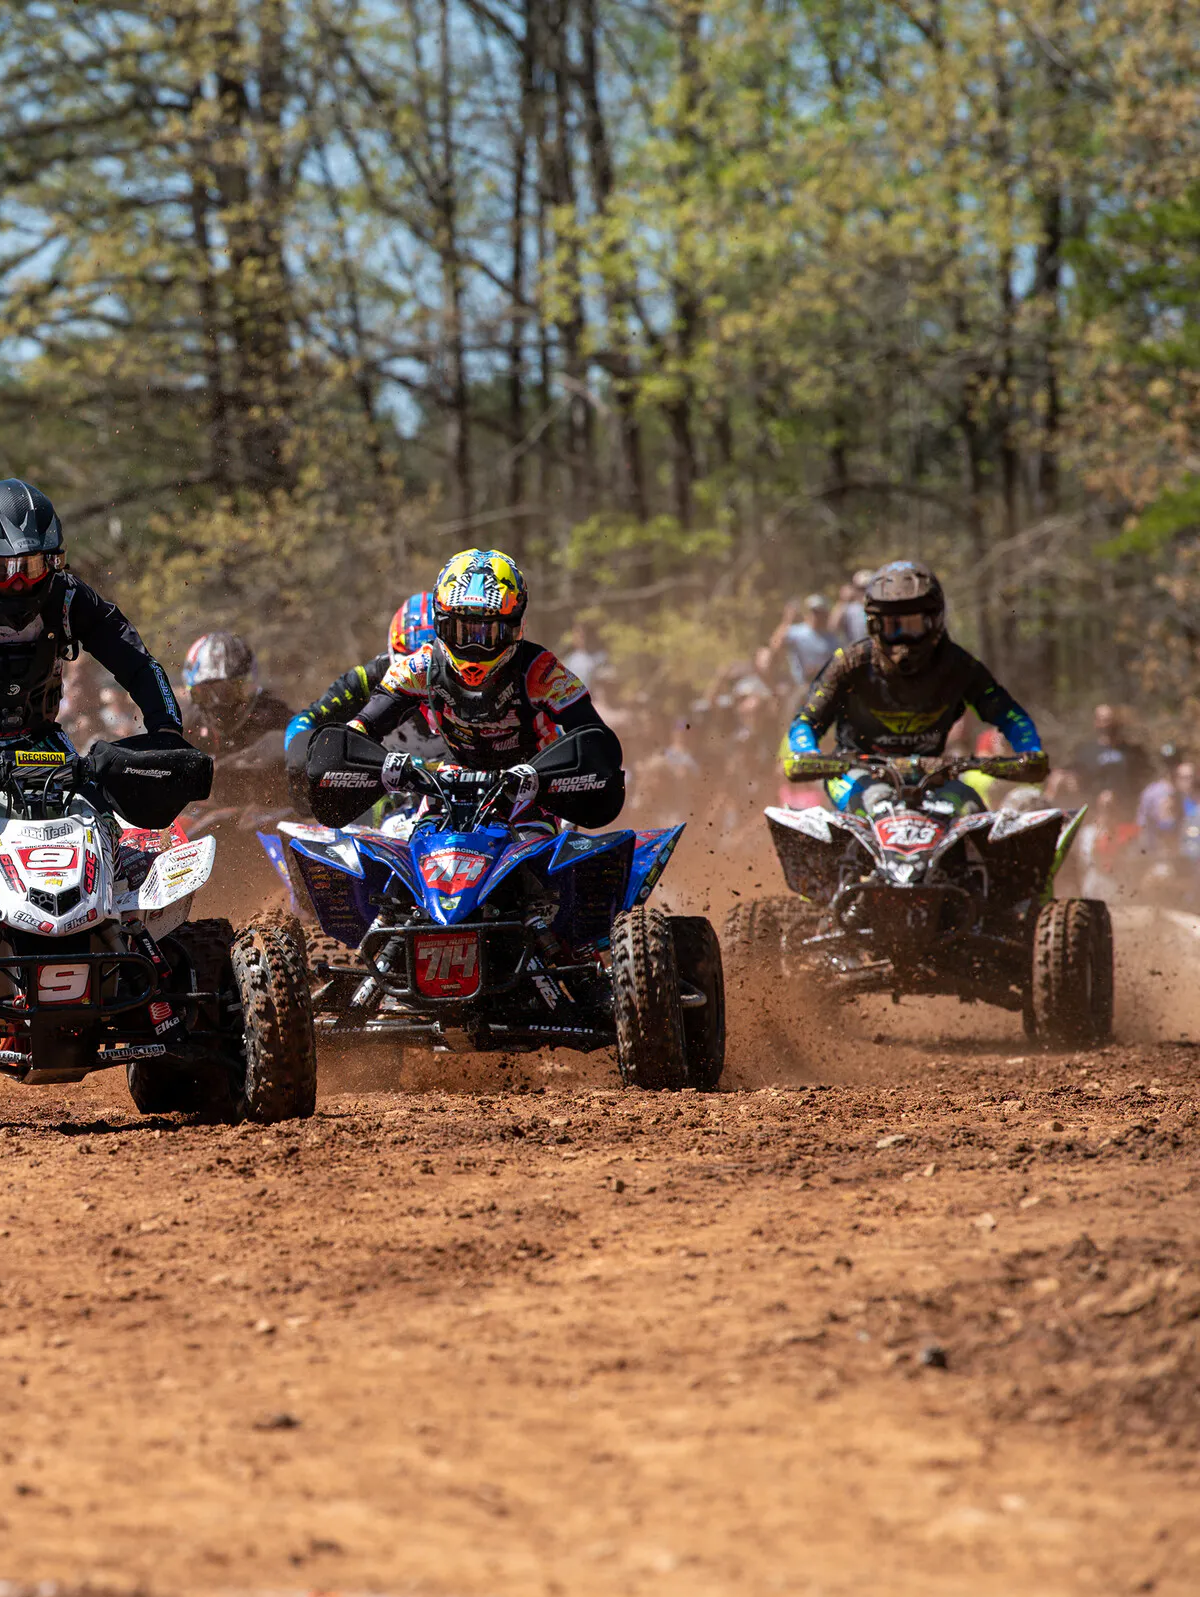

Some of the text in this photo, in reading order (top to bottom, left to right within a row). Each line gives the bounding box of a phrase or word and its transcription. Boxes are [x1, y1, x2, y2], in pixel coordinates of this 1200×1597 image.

[323, 771, 369, 780] MOOSE
[329, 780, 378, 788] RACING
[550, 774, 597, 785] MOOSE
[557, 781, 606, 793] RACING
[26, 848, 75, 868] 9
[84, 849, 96, 895] GBC
[425, 859, 485, 882] 714
[14, 910, 41, 926] Elka
[64, 912, 89, 932] Elka
[142, 938, 155, 956] Elka
[418, 944, 478, 980] 714
[38, 964, 90, 1002] 9
[154, 1016, 180, 1036] Elka
